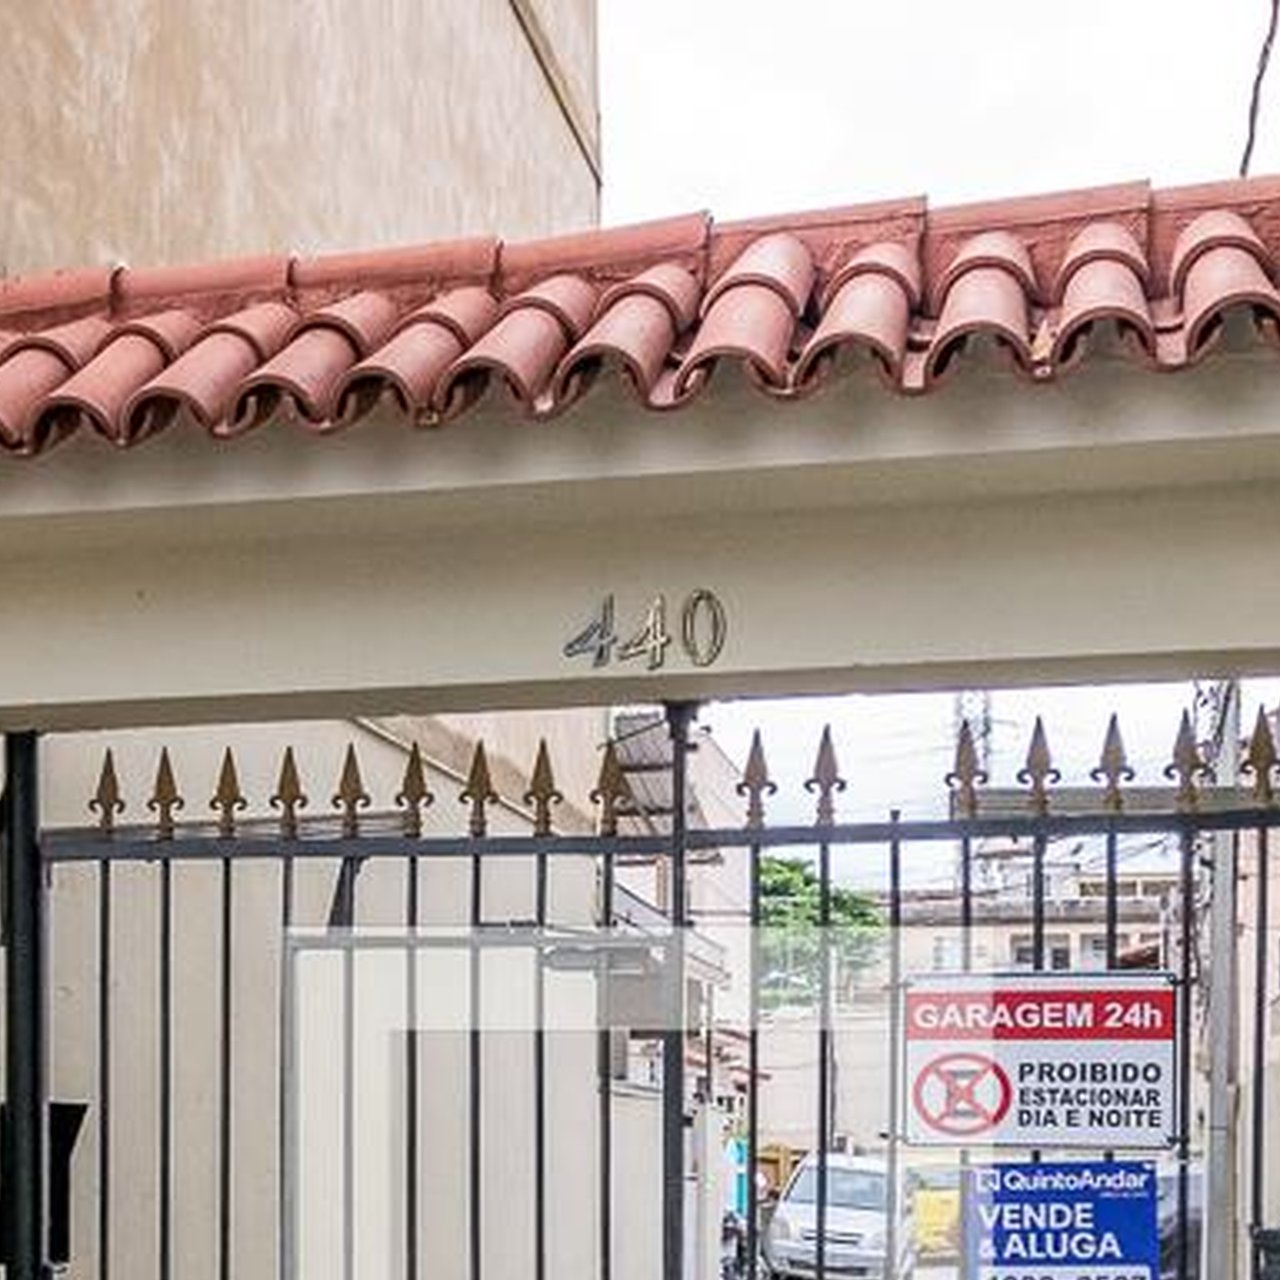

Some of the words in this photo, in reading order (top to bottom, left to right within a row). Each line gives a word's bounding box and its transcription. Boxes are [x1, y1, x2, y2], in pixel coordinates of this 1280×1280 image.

[563, 588, 727, 670] 440
[913, 1002, 1093, 1029] GARAGEM
[1104, 1002, 1162, 1029] 24h
[1018, 1062, 1162, 1084] PROIBIDO
[1018, 1087, 1162, 1107] ESTACIONAR
[1017, 1109, 1059, 1128] DIA
[1065, 1110, 1081, 1128] E
[1088, 1110, 1162, 1128] NOITE
[1003, 1170, 1150, 1191] QuintoAndar
[978, 1202, 1095, 1230] VENDE
[1002, 1232, 1123, 1259] ALUGA
